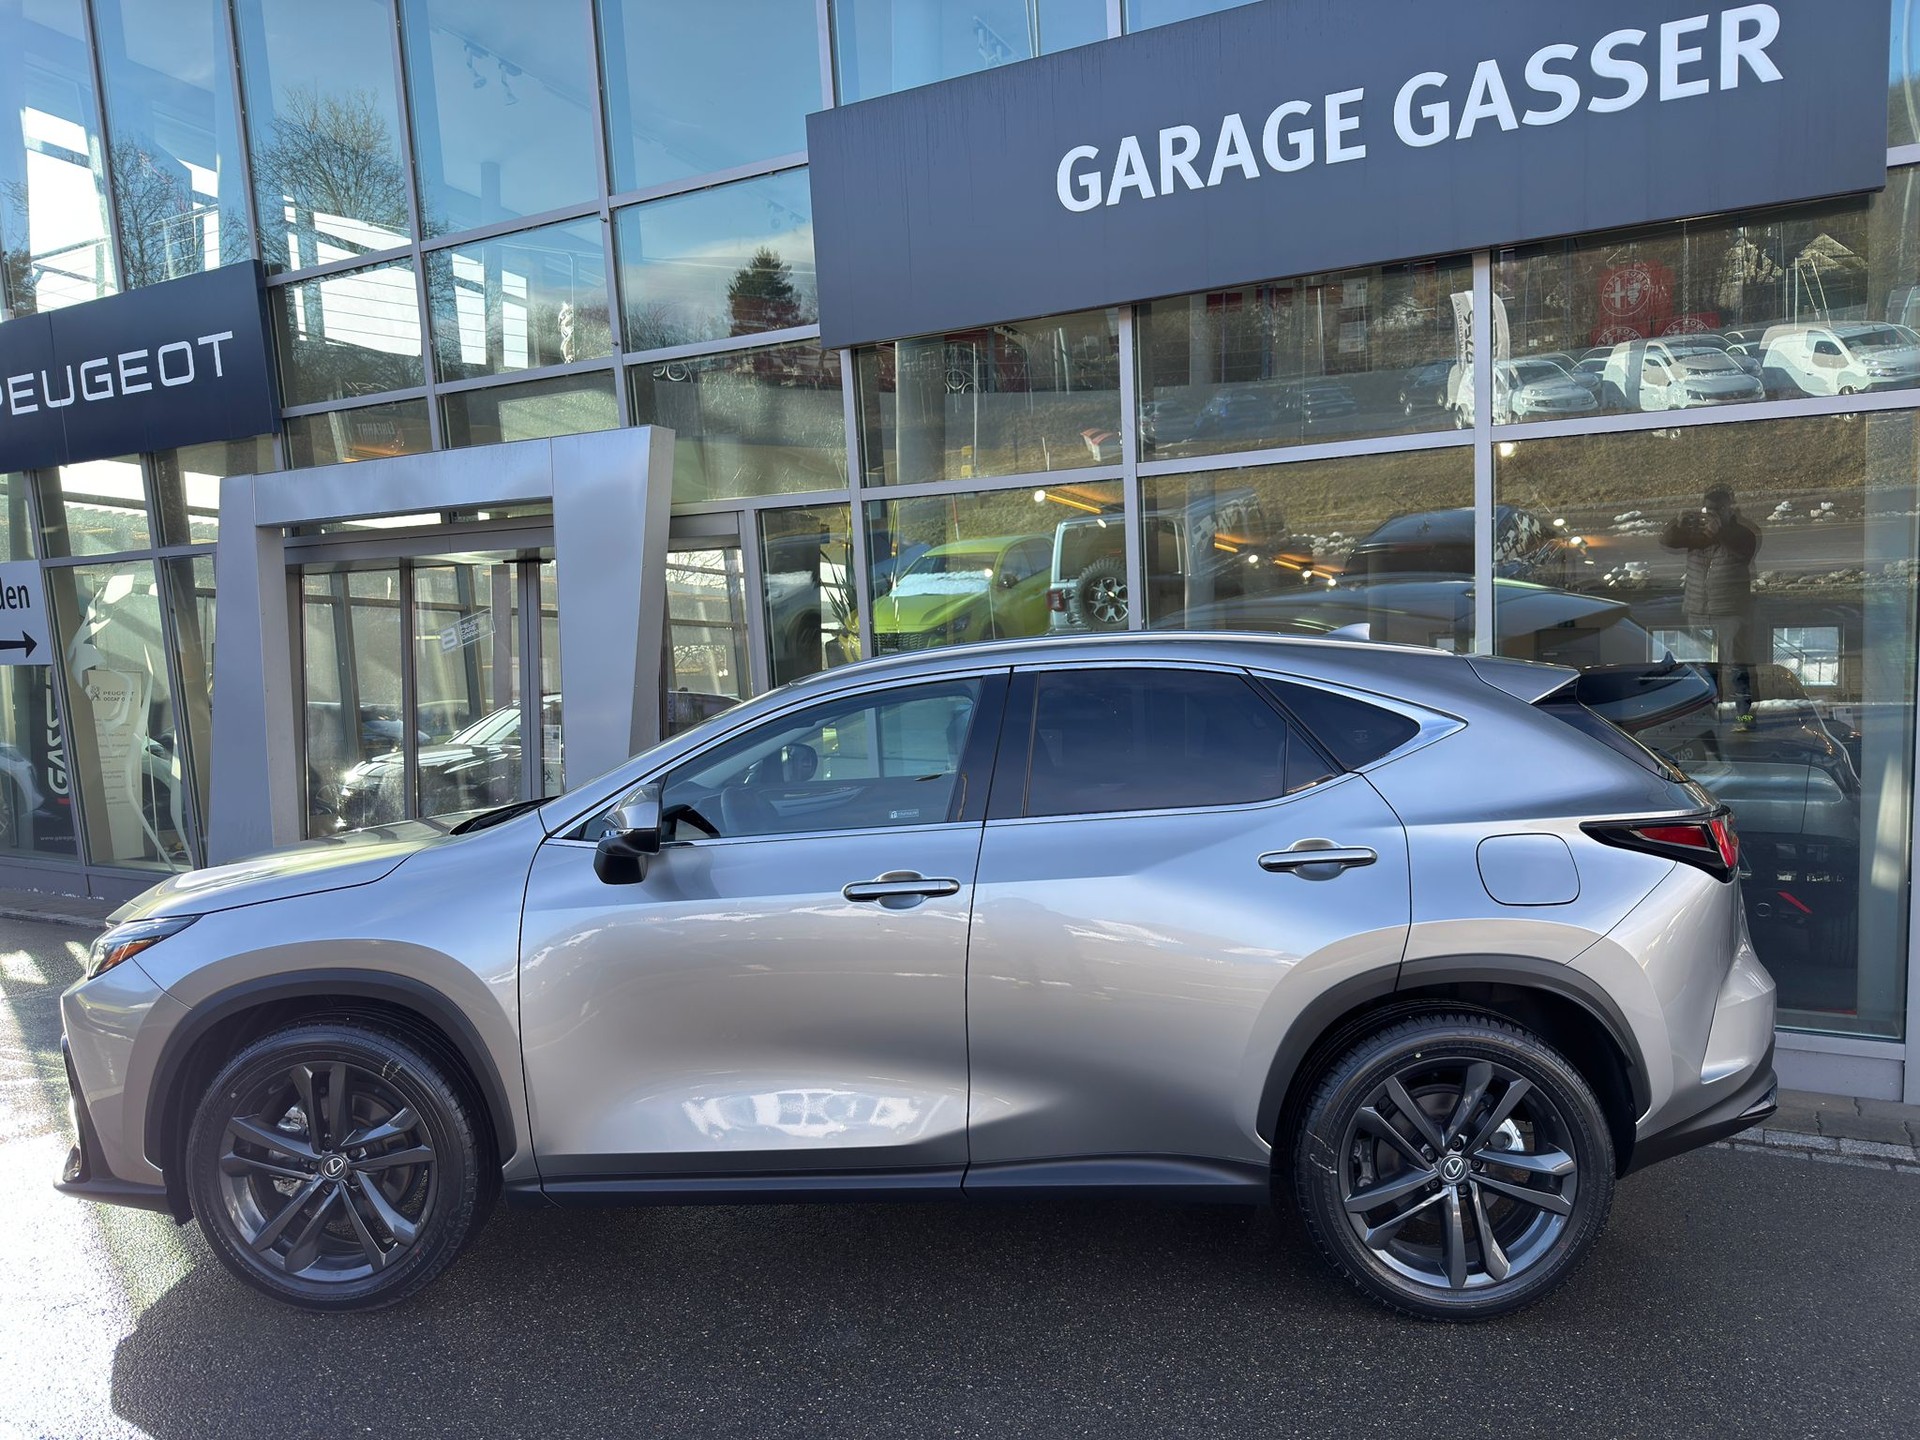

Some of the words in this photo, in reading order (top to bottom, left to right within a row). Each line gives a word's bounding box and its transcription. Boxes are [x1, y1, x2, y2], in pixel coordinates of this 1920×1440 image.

[1056, 88, 1367, 212] GARAGE
[1392, 2, 1785, 149] GASSER
[0, 330, 234, 416] EUGEOT
